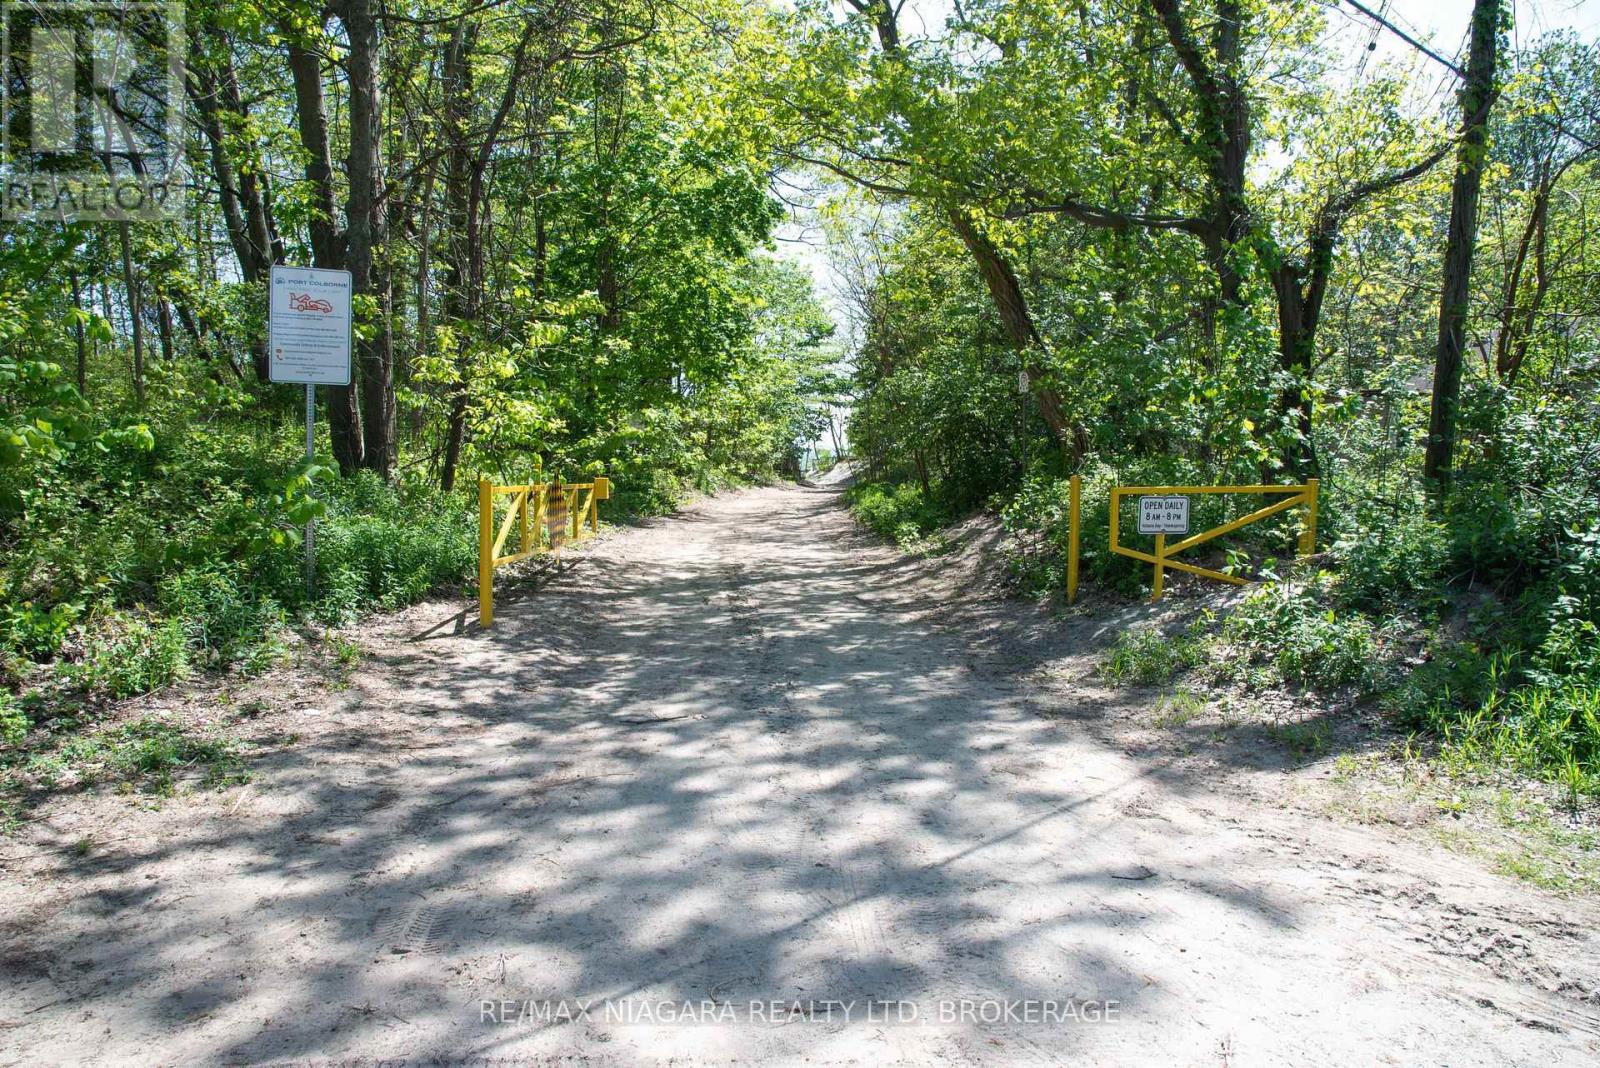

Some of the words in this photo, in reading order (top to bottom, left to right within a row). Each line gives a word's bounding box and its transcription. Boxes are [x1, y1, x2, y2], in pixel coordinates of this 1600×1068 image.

[309, 280, 348, 288] COLBORNE
[1144, 501, 1163, 510] OPEN
[1164, 501, 1184, 510] DAILY
[1146, 512, 1150, 520] 8
[1166, 512, 1172, 520] 8
